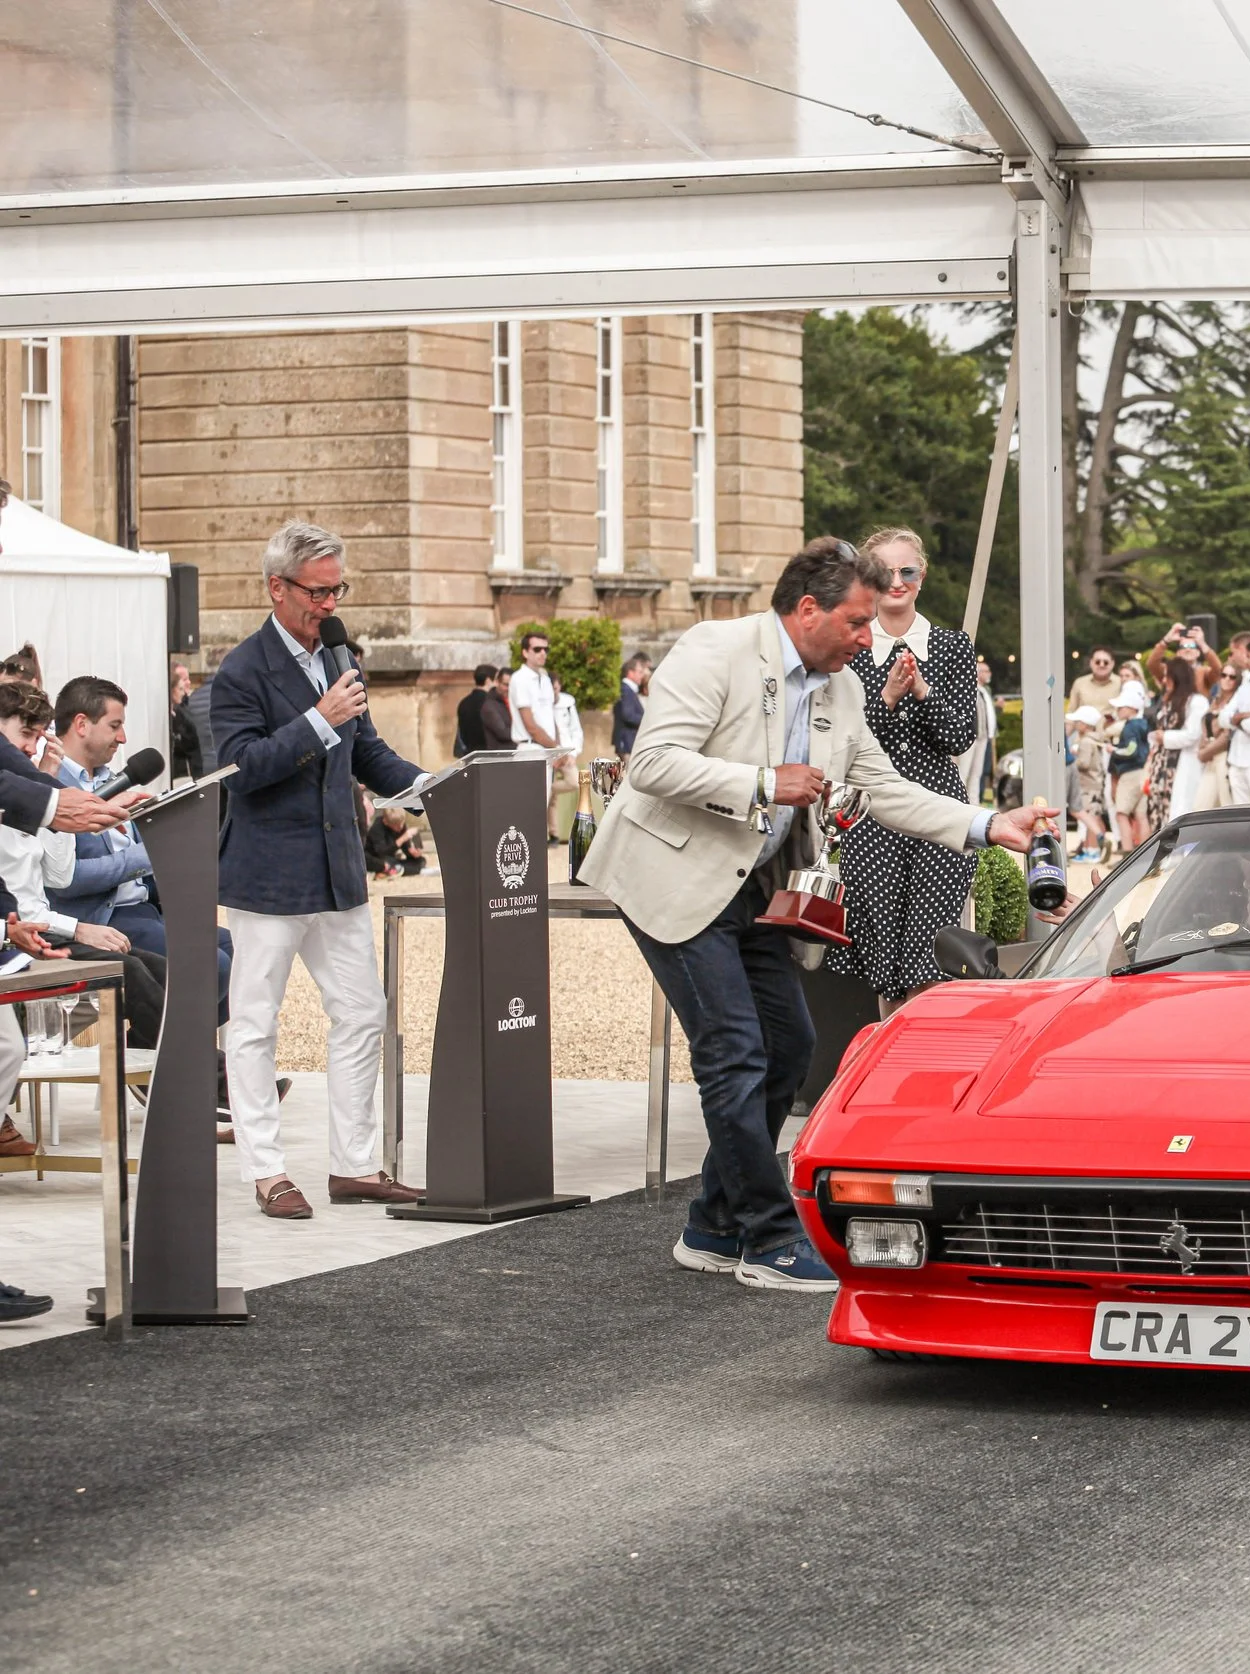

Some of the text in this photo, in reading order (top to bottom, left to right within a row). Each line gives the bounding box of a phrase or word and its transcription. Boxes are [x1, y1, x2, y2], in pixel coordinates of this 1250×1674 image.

[503, 843, 521, 852] SALON
[489, 894, 538, 909] CLUB TROPHY
[491, 907, 537, 919] presented by Lockton
[498, 1015, 536, 1031] LOCKTON
[1100, 1310, 1191, 1355] CRA
